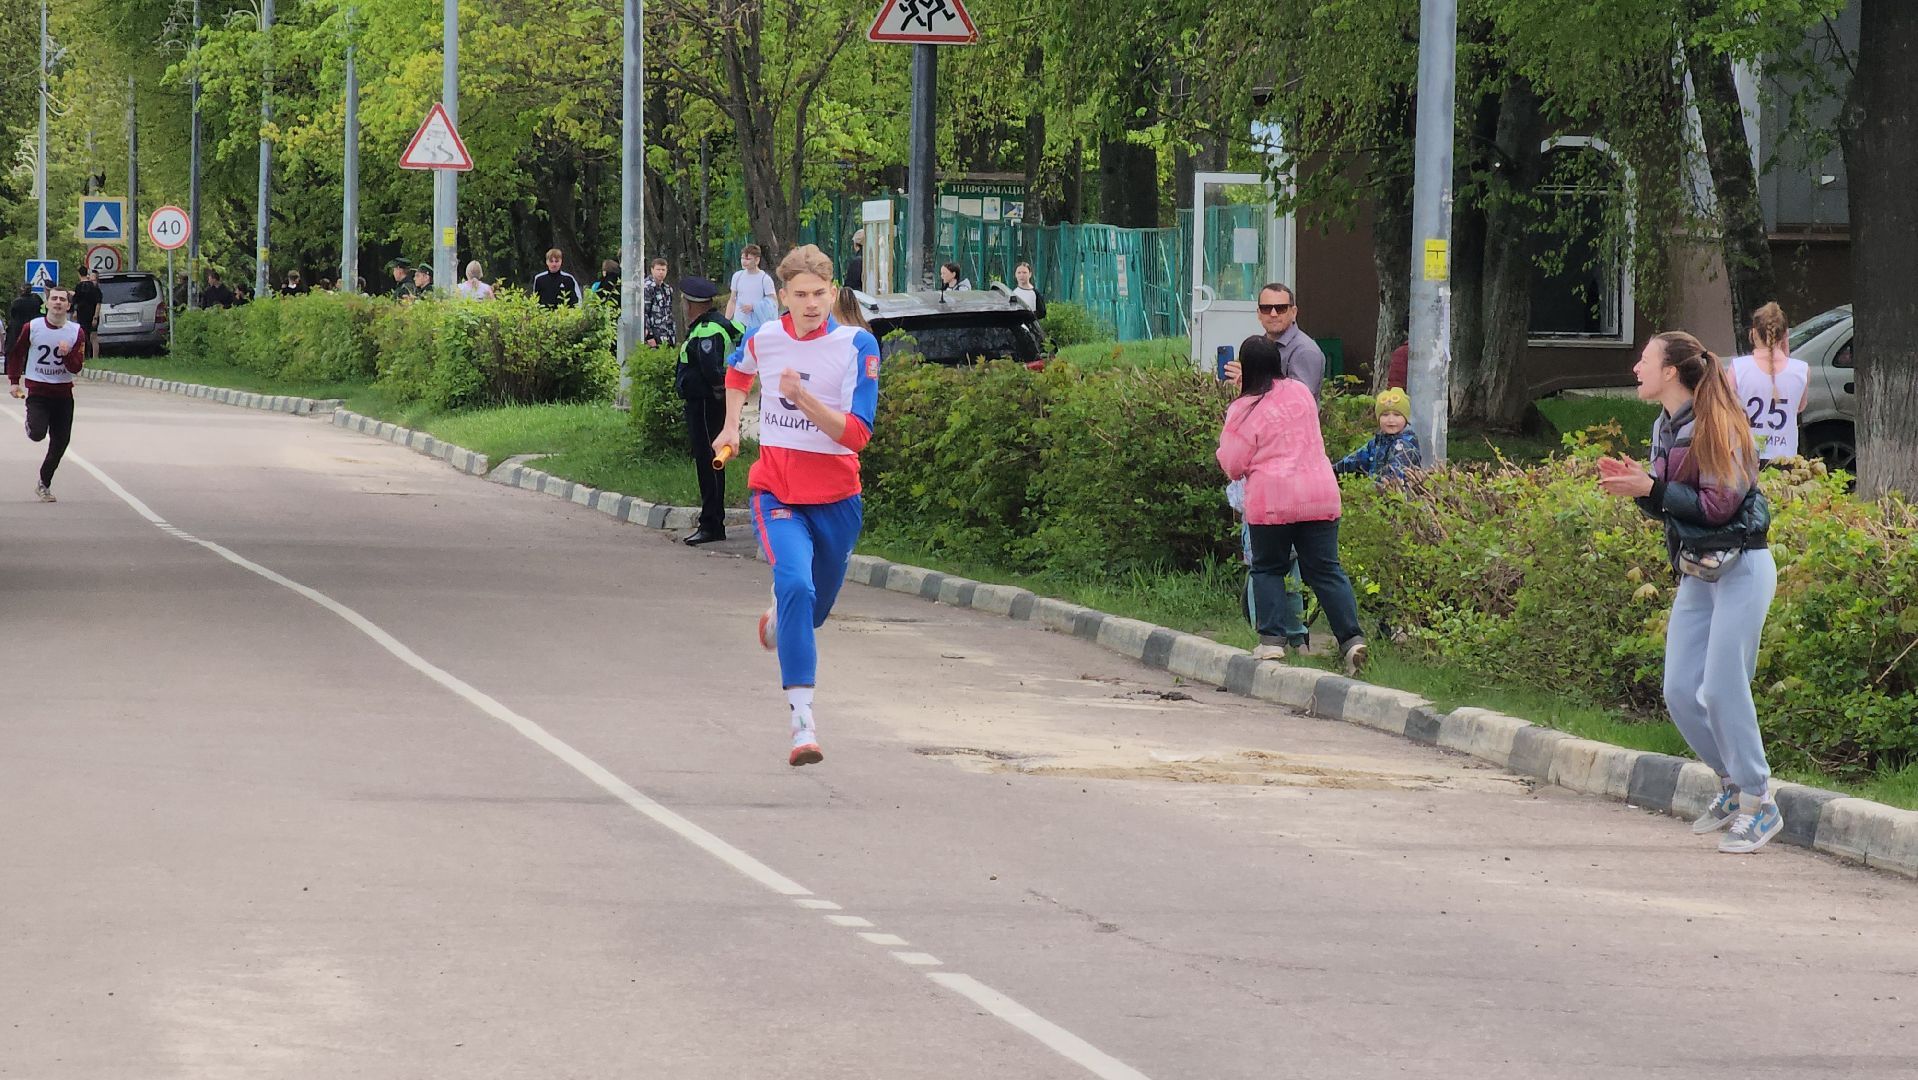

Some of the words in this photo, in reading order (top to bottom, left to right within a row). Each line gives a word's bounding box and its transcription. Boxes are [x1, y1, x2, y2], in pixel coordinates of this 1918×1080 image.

[157, 220, 181, 235] 40
[93, 255, 114, 270] 20
[764, 411, 820, 433] КАШИР
[1747, 396, 1788, 430] 25
